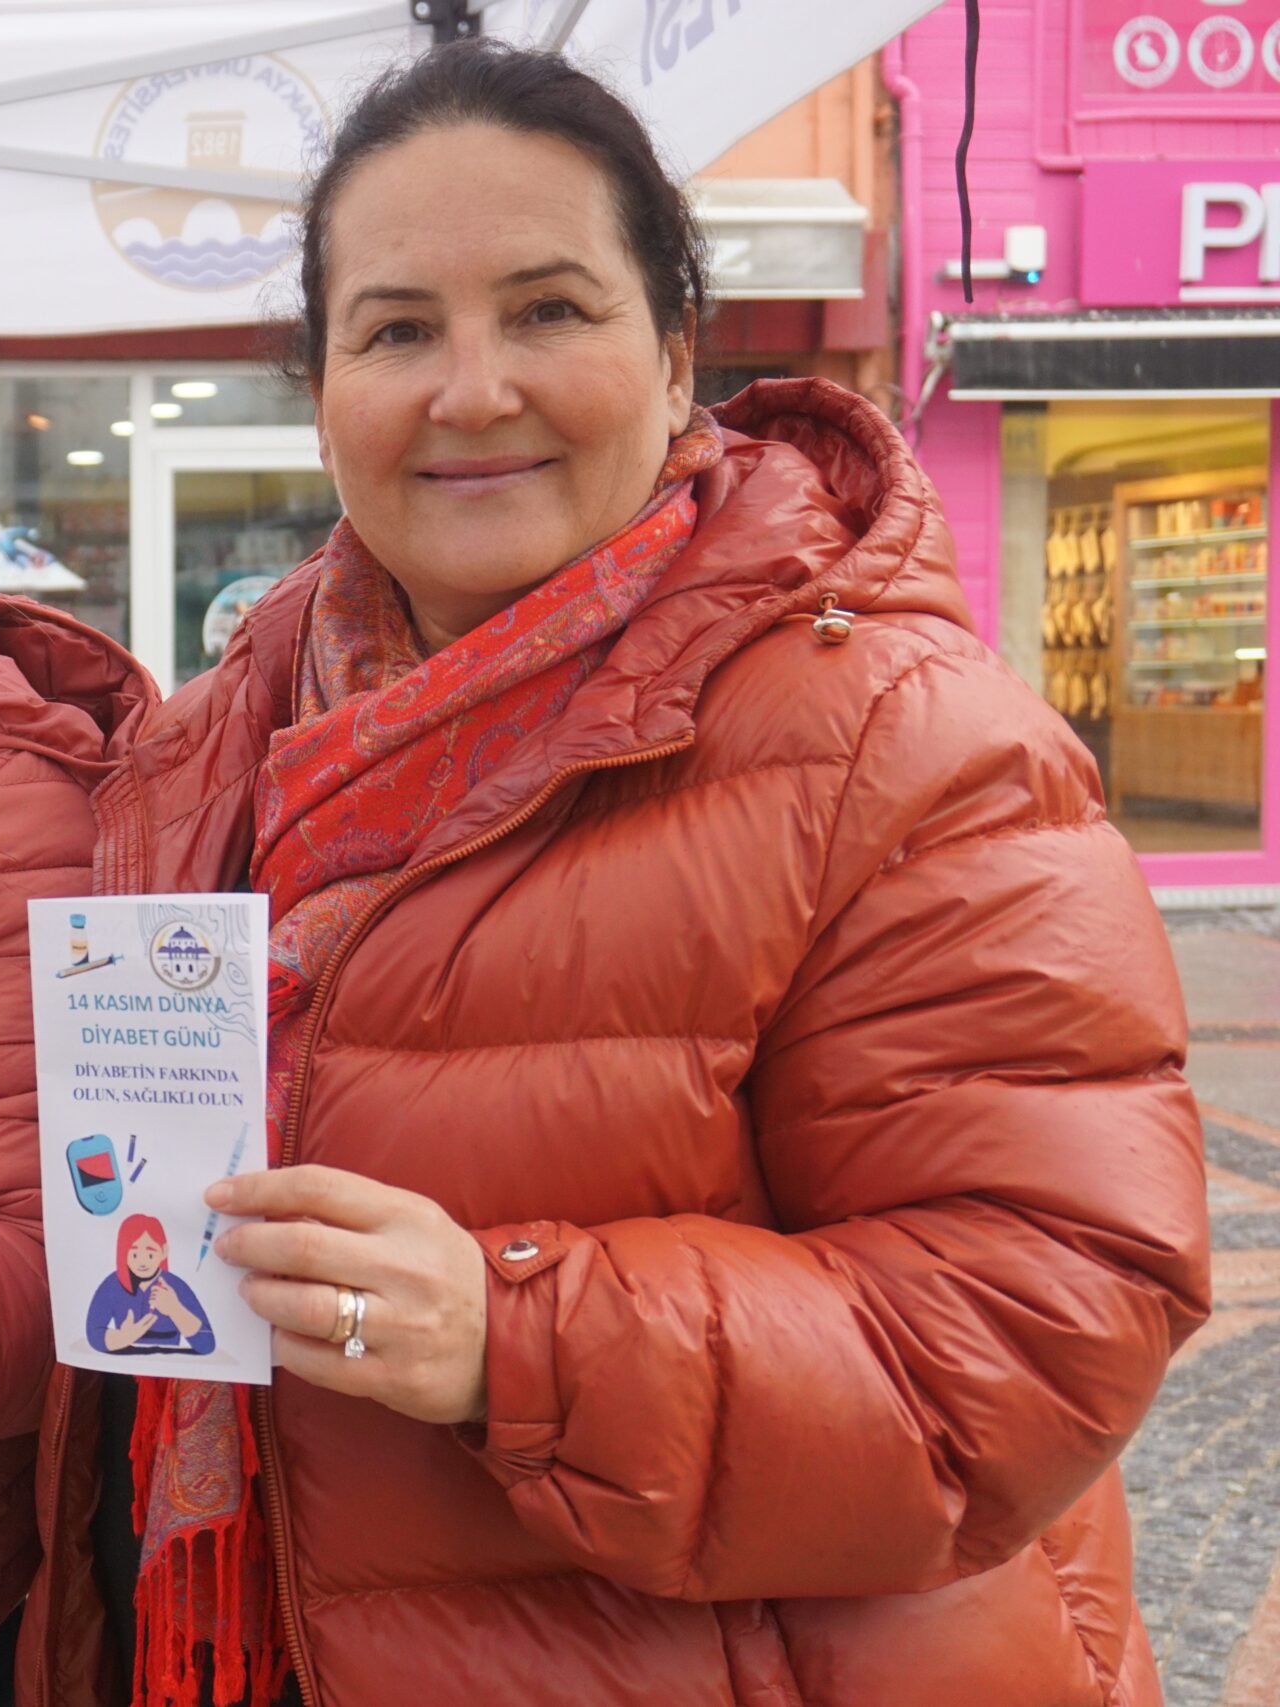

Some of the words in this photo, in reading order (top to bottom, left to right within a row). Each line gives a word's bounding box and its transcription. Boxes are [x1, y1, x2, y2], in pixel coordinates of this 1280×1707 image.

[67, 993, 89, 1010] 14
[94, 995, 153, 1012] KASIM
[158, 992, 229, 1014] DÜNYA
[81, 1023, 159, 1046] DİYABET
[163, 1025, 222, 1048] GÜNÜ
[74, 1061, 155, 1080] DİYABETİN
[159, 1067, 239, 1083] FARKINDA
[72, 1087, 120, 1104] OLUN,
[122, 1087, 194, 1106] SAĞLIKLI
[198, 1092, 244, 1107] OLUN
